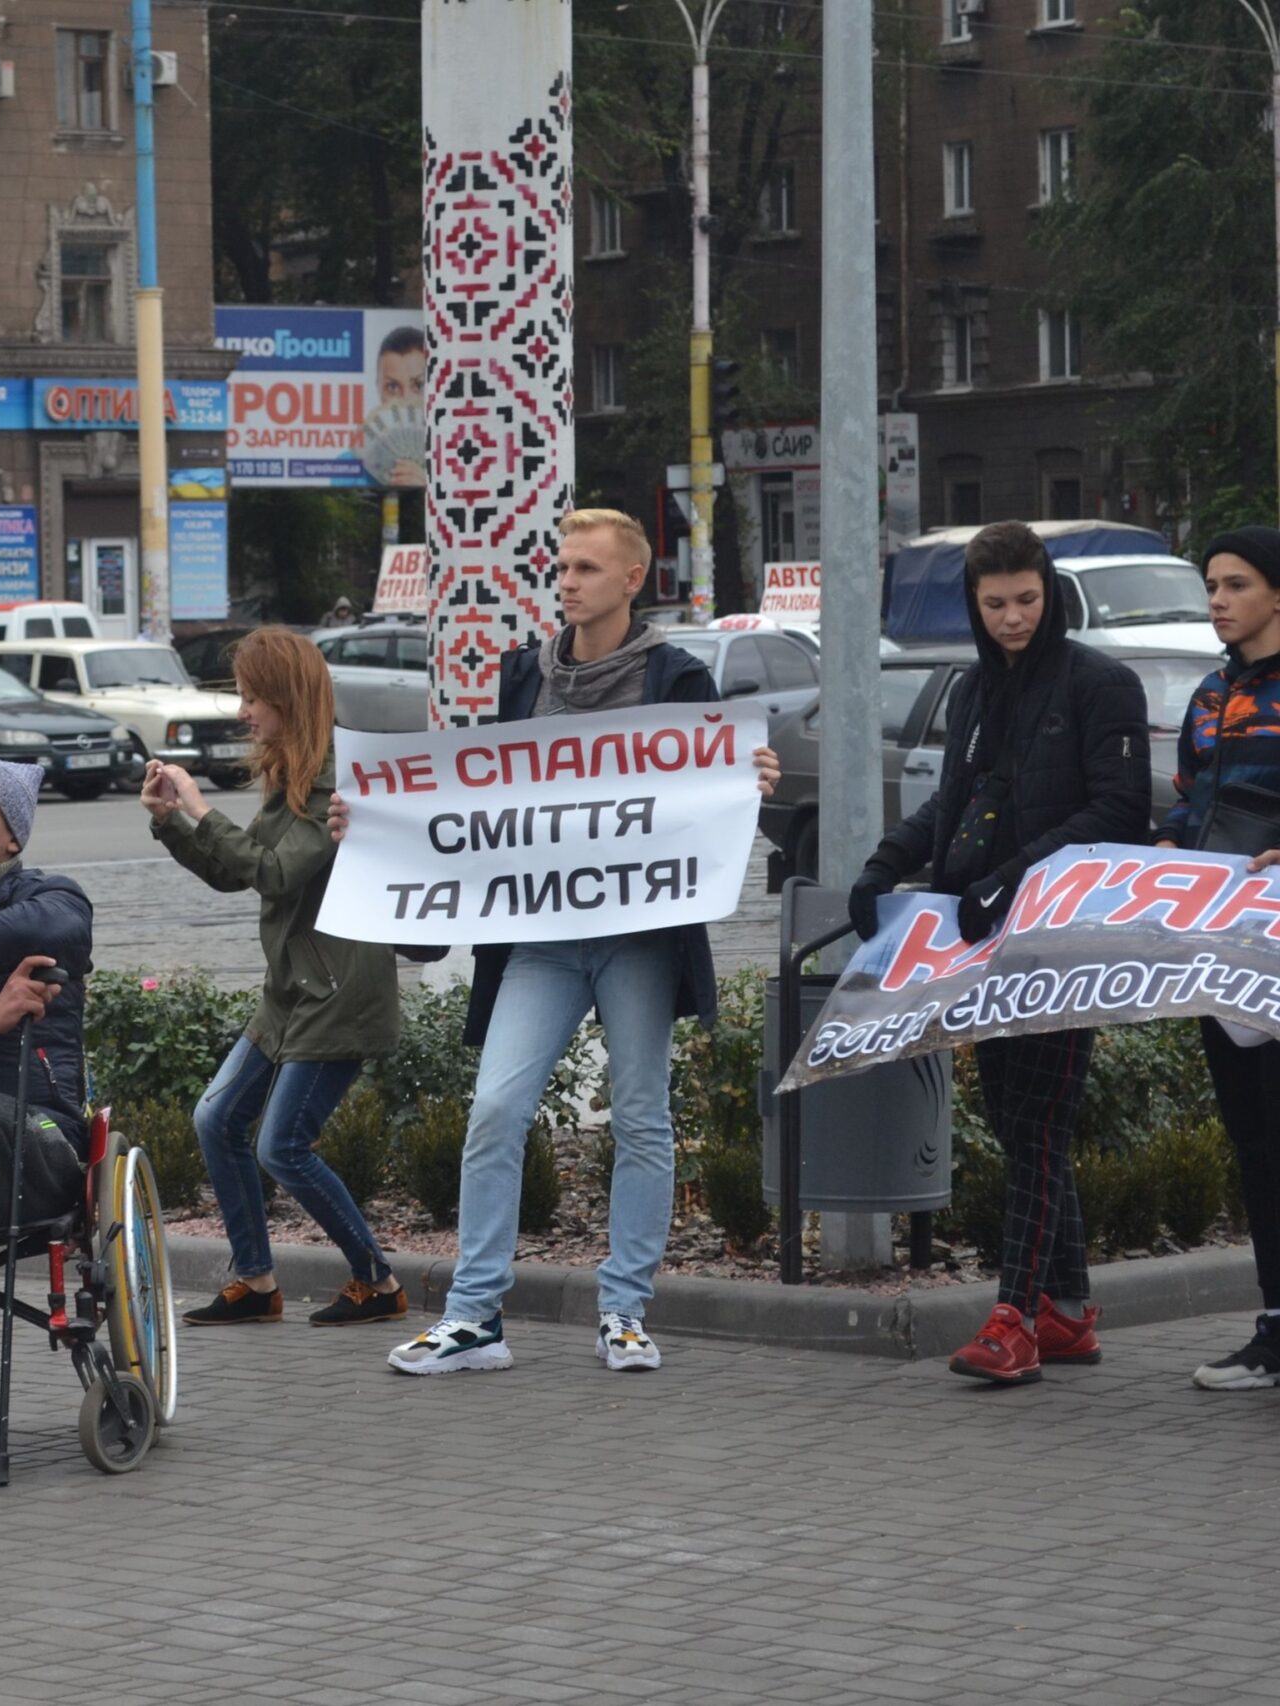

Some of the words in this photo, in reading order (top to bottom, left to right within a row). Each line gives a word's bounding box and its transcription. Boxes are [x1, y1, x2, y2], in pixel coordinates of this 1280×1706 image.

[246, 428, 365, 448] ЗАРПЛАТИ
[352, 754, 437, 796] НЕ
[455, 713, 736, 788] СПАЛЮЙ
[428, 796, 656, 854] СМІТТЯ
[386, 880, 461, 920] ТА
[479, 856, 698, 918] ЛИСТЯ!
